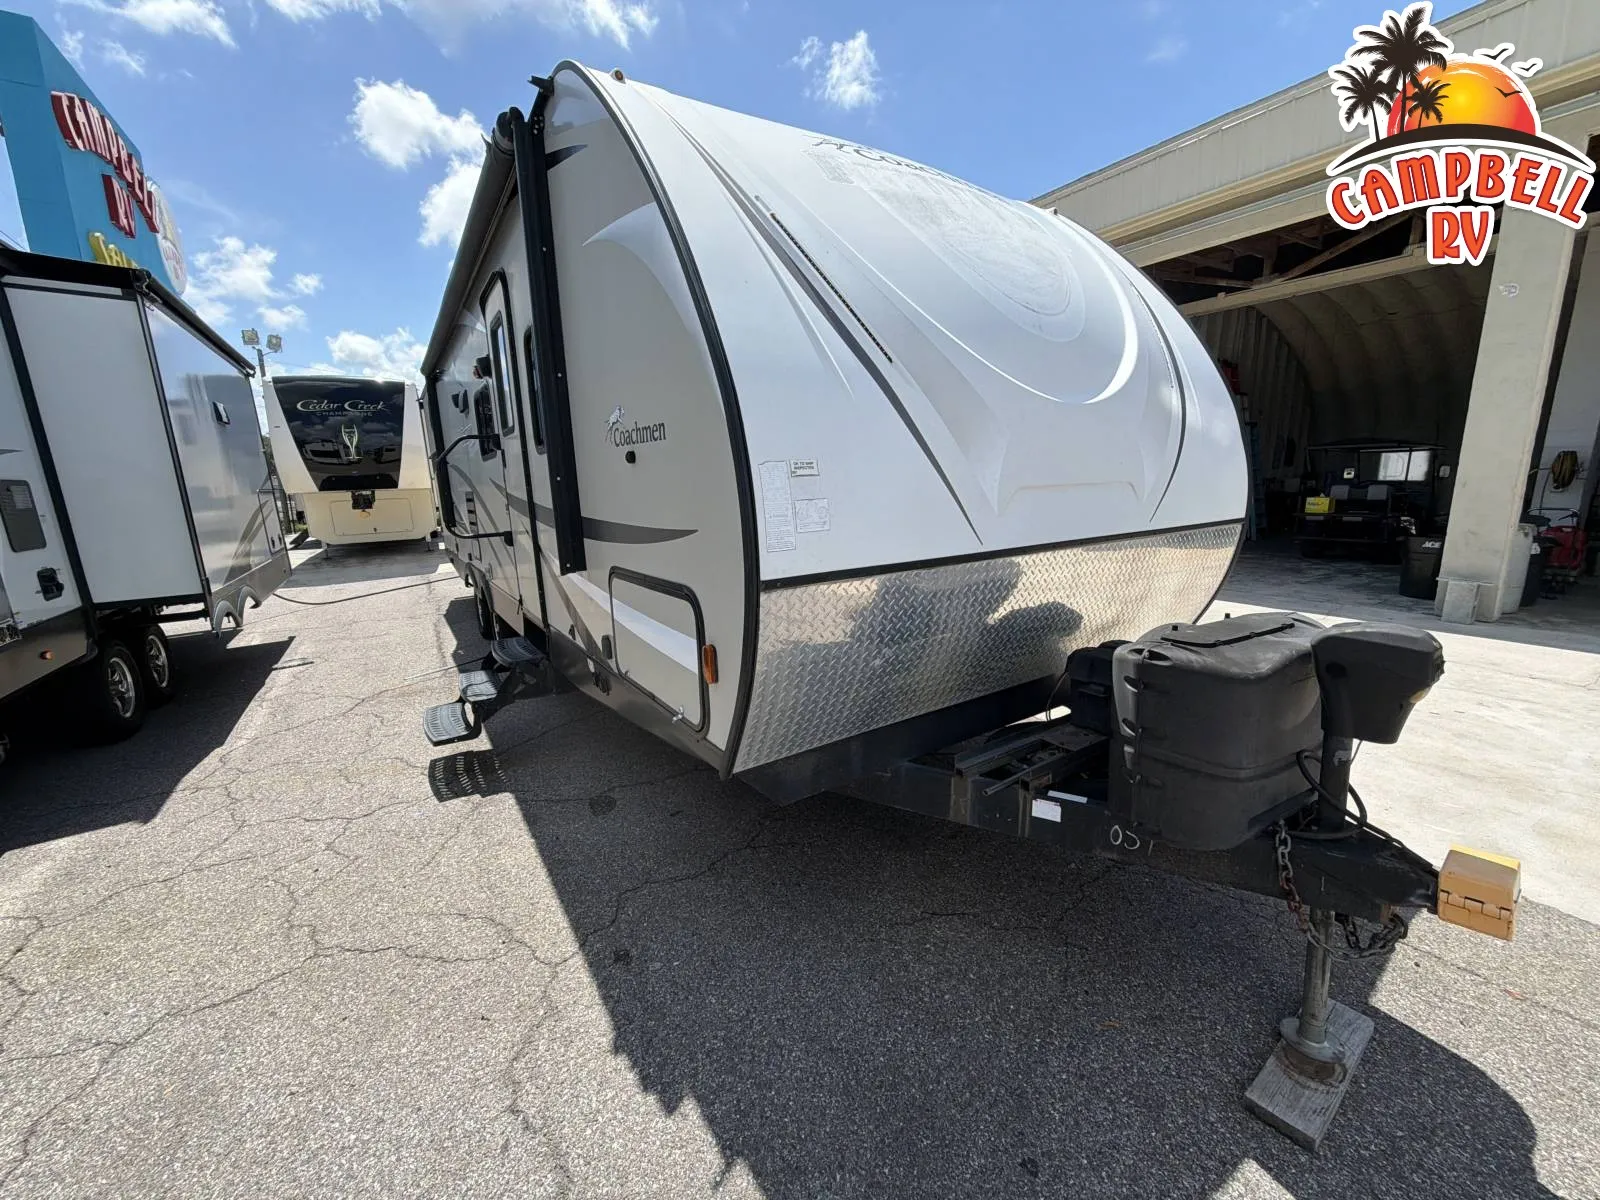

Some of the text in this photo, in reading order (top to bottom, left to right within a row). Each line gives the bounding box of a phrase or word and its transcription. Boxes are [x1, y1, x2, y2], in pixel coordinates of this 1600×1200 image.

[102, 173, 137, 239] RV
[296, 399, 388, 412] Cedar Creek
[613, 420, 666, 447] Coachmen
[1421, 540, 1442, 549] ACE
